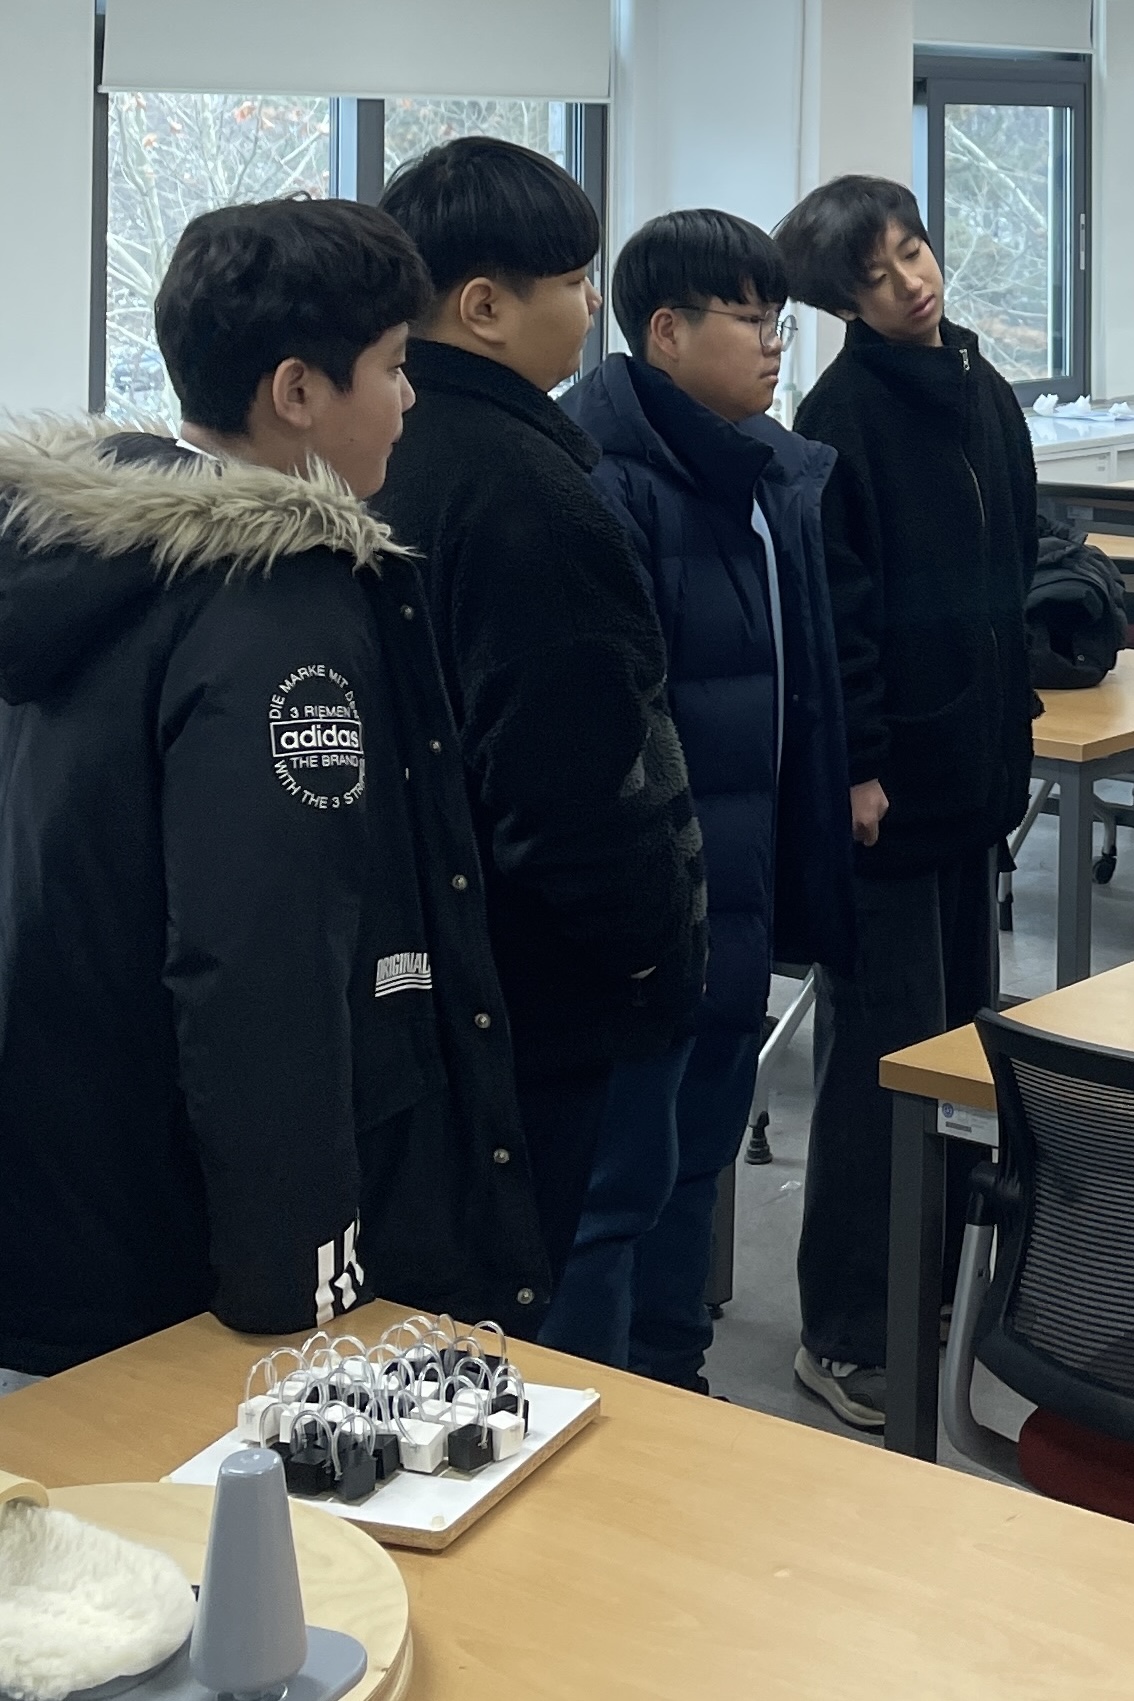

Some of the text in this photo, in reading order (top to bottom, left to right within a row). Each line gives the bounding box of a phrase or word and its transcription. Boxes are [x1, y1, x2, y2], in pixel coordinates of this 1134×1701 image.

[269, 694, 286, 719] DIE
[279, 664, 326, 693] MARKE
[329, 668, 349, 689] MIT
[289, 705, 351, 719] 3 RIEMEN
[280, 724, 359, 749] adidas
[289, 754, 359, 769] THE BRAND
[274, 759, 301, 796] WITH
[301, 789, 329, 809] THE
[331, 796, 341, 809] 3
